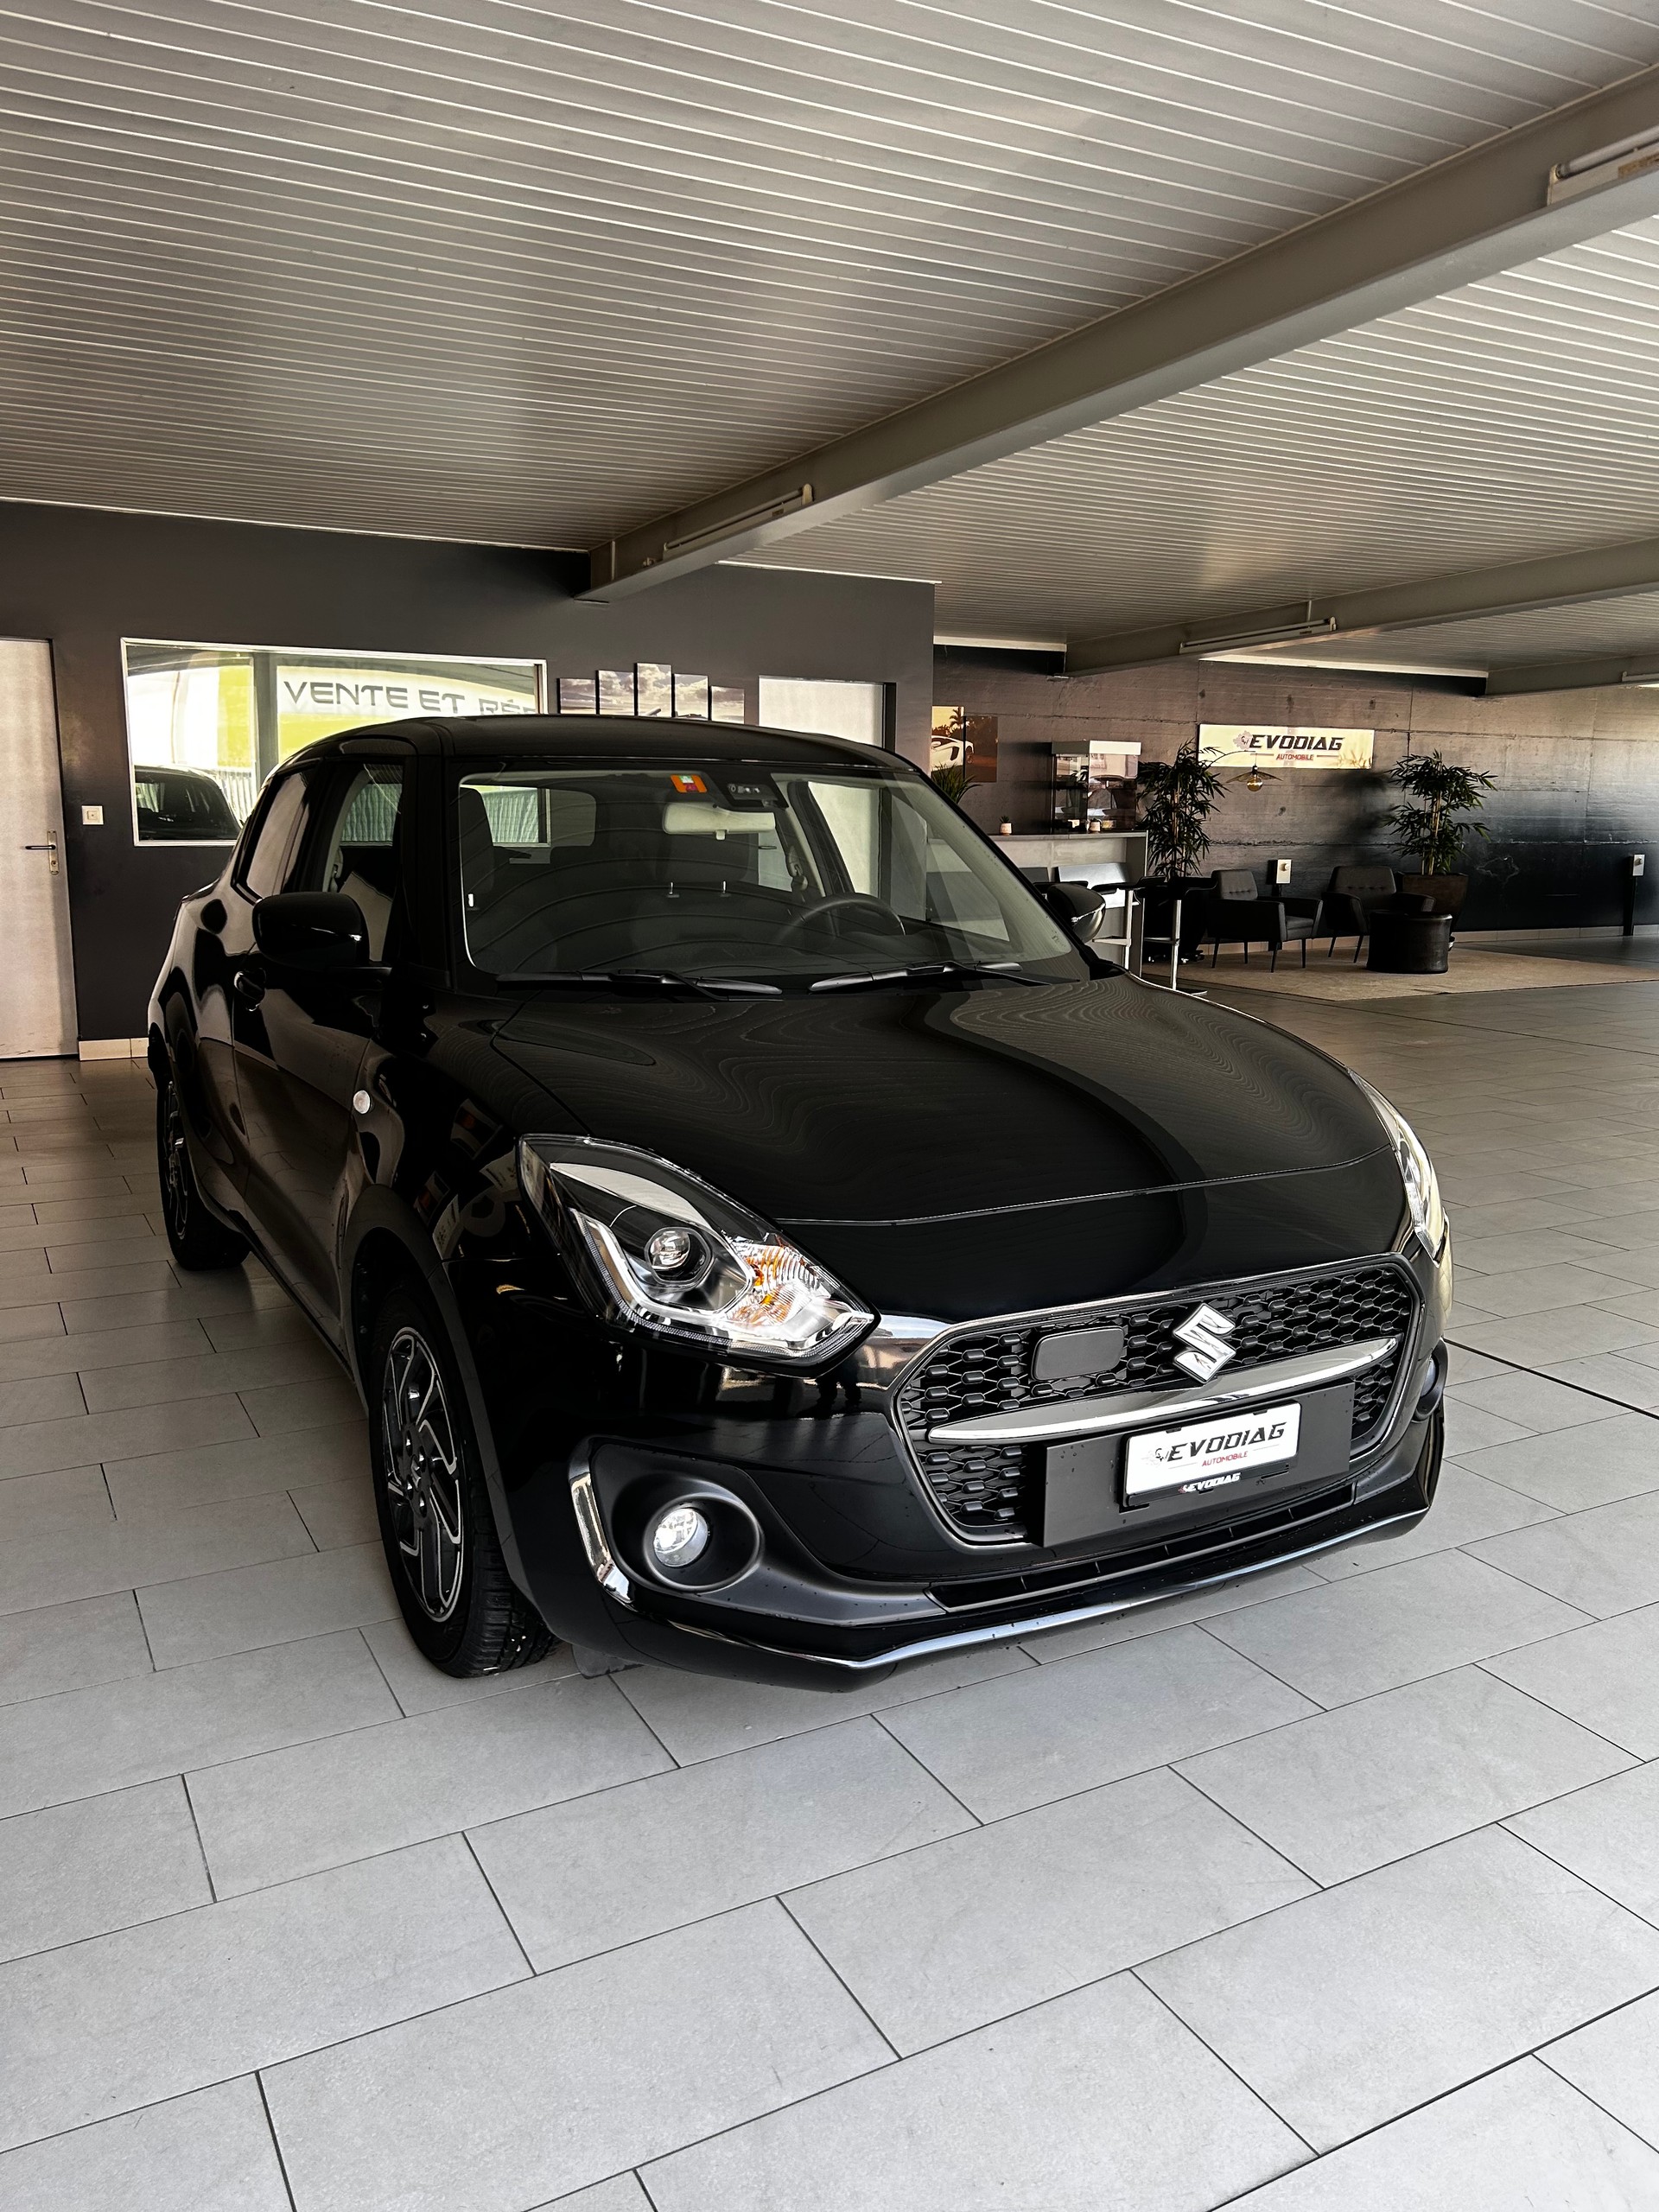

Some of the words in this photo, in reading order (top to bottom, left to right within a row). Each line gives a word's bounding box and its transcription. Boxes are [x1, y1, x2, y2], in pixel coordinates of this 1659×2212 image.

[283, 681, 409, 709] VENTE
[418, 689, 466, 715] ET
[1249, 734, 1345, 751] EVODIAG
[1166, 1421, 1287, 1462] EVODIAG
[1202, 1451, 1249, 1467] AUTOMOBILE
[1187, 1472, 1242, 1492] EVODIAG
